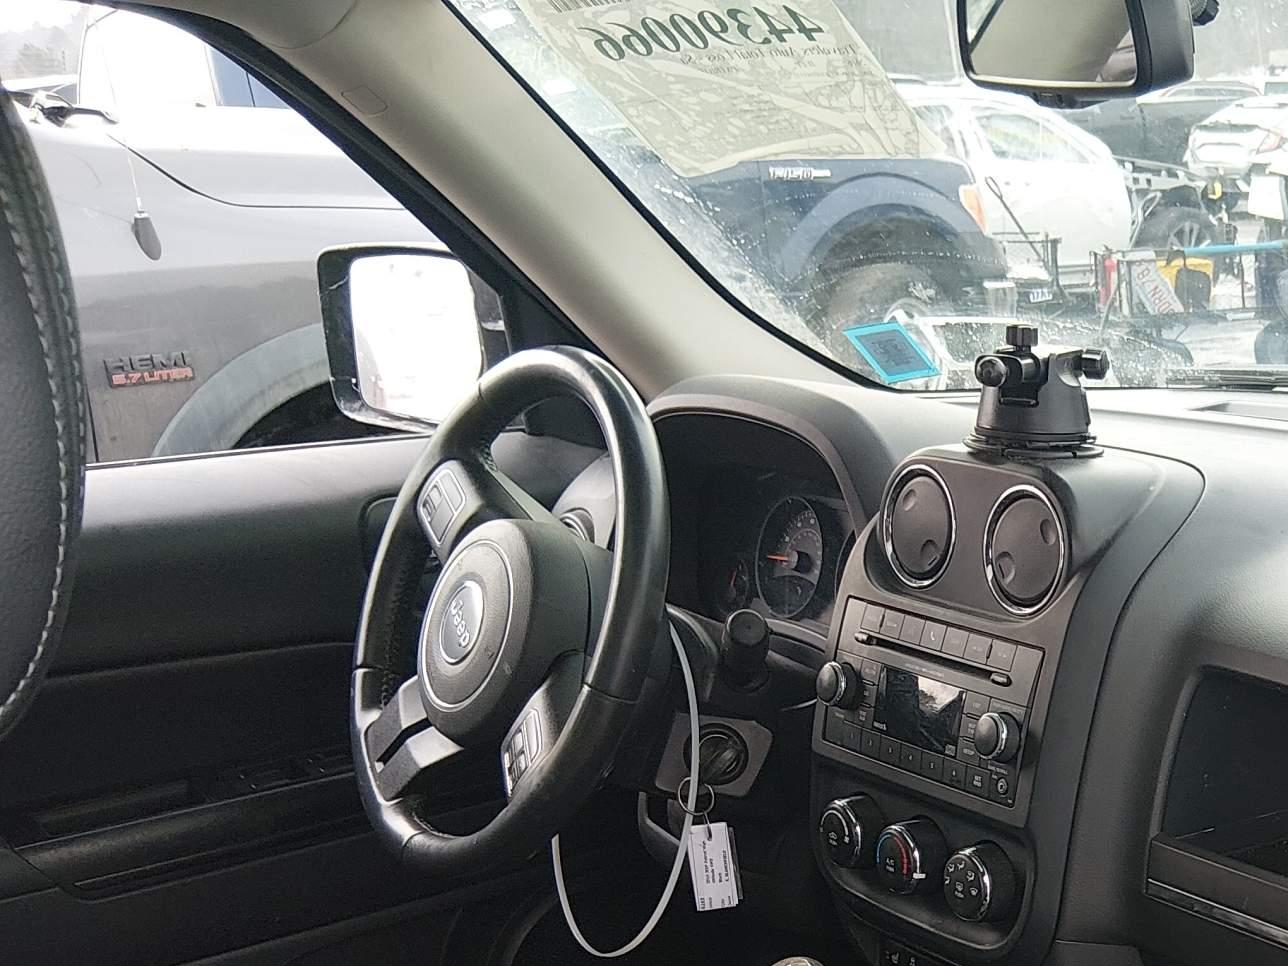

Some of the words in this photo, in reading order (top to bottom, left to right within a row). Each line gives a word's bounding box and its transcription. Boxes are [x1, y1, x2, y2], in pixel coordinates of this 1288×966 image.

[103, 351, 192, 372] HEMI
[112, 373, 142, 385] 5.7
[143, 367, 193, 383] LITER
[449, 599, 471, 649] Jeep
